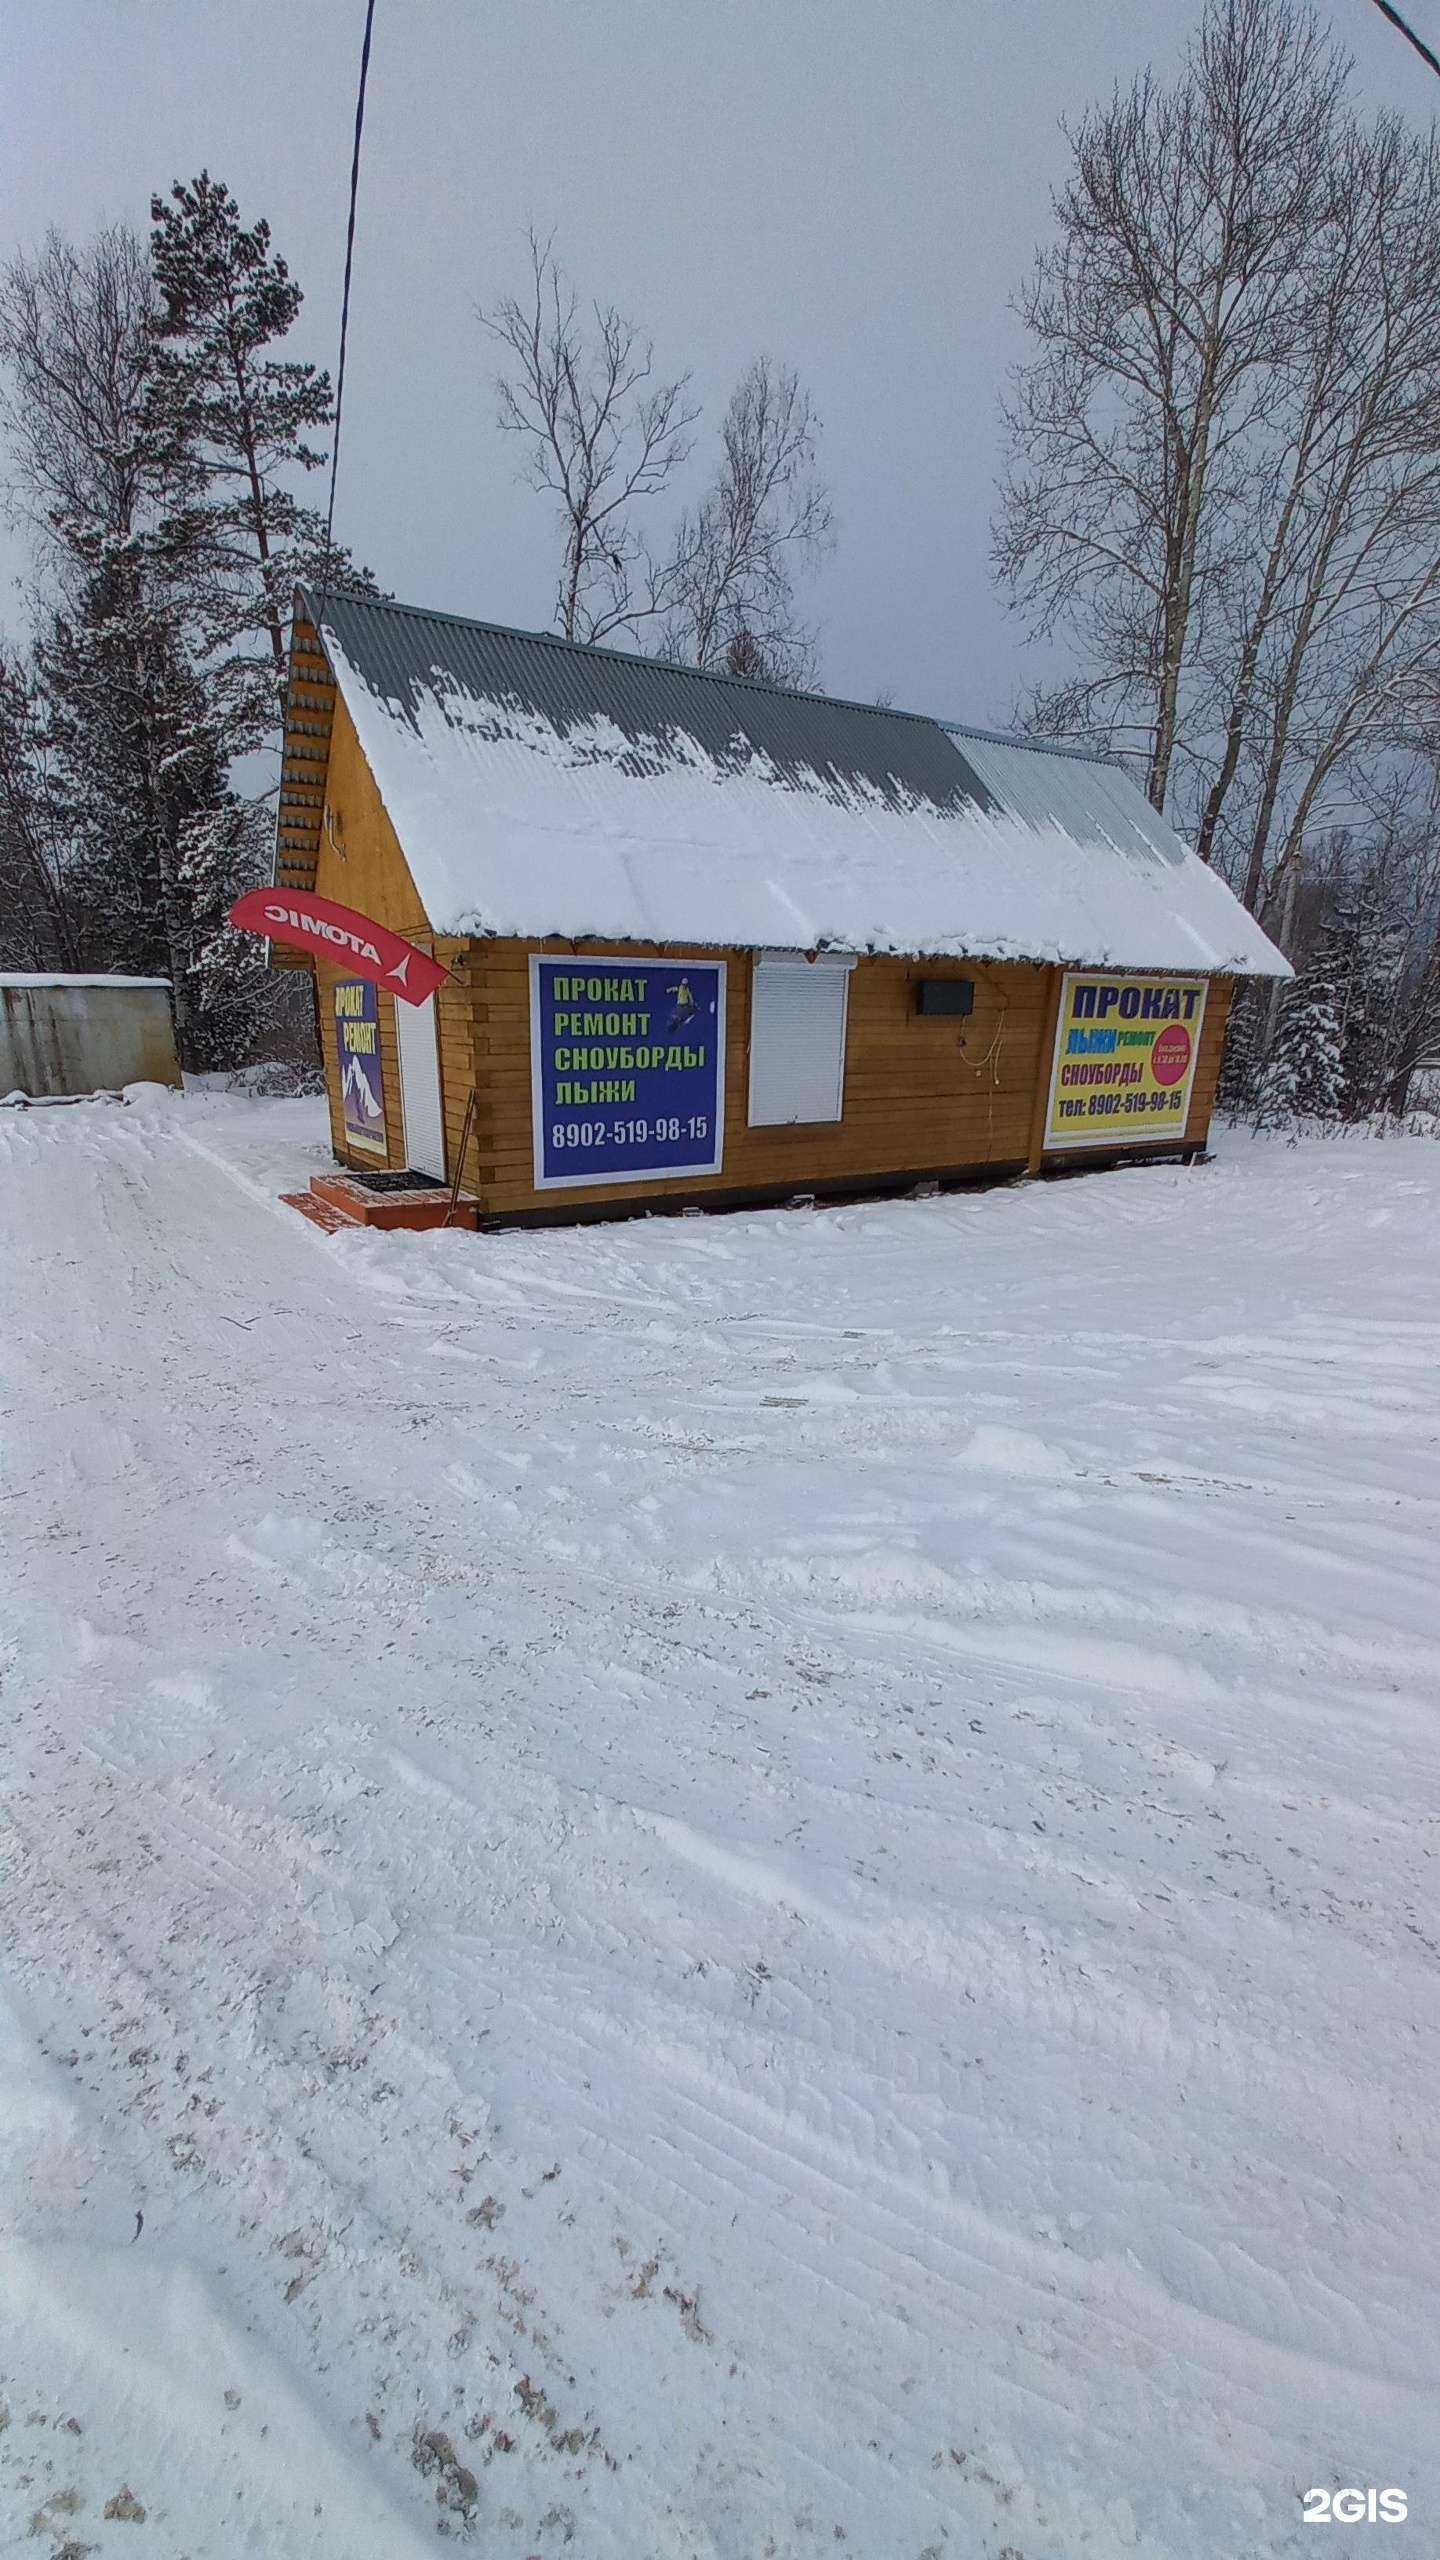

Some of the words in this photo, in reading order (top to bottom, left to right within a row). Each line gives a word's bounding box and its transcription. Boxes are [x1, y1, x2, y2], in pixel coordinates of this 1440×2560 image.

[553, 977, 648, 1002] ПРОКАТ
[1072, 986, 1200, 1020] ПРОКАТ
[554, 1012, 650, 1036] РЕМОНТ
[343, 1022, 376, 1055] РЕМОНТ
[1065, 1028, 1118, 1055] ЛЫЖИ
[554, 1045, 706, 1071] СНОУБОРДЫ
[1061, 1062, 1144, 1087] СНОУБОРДЫ
[555, 1080, 636, 1105] ЛЫЖИ
[1088, 1090, 1182, 1117] 8902-519-98-15
[552, 1116, 708, 1148] 8902-519-98-15
